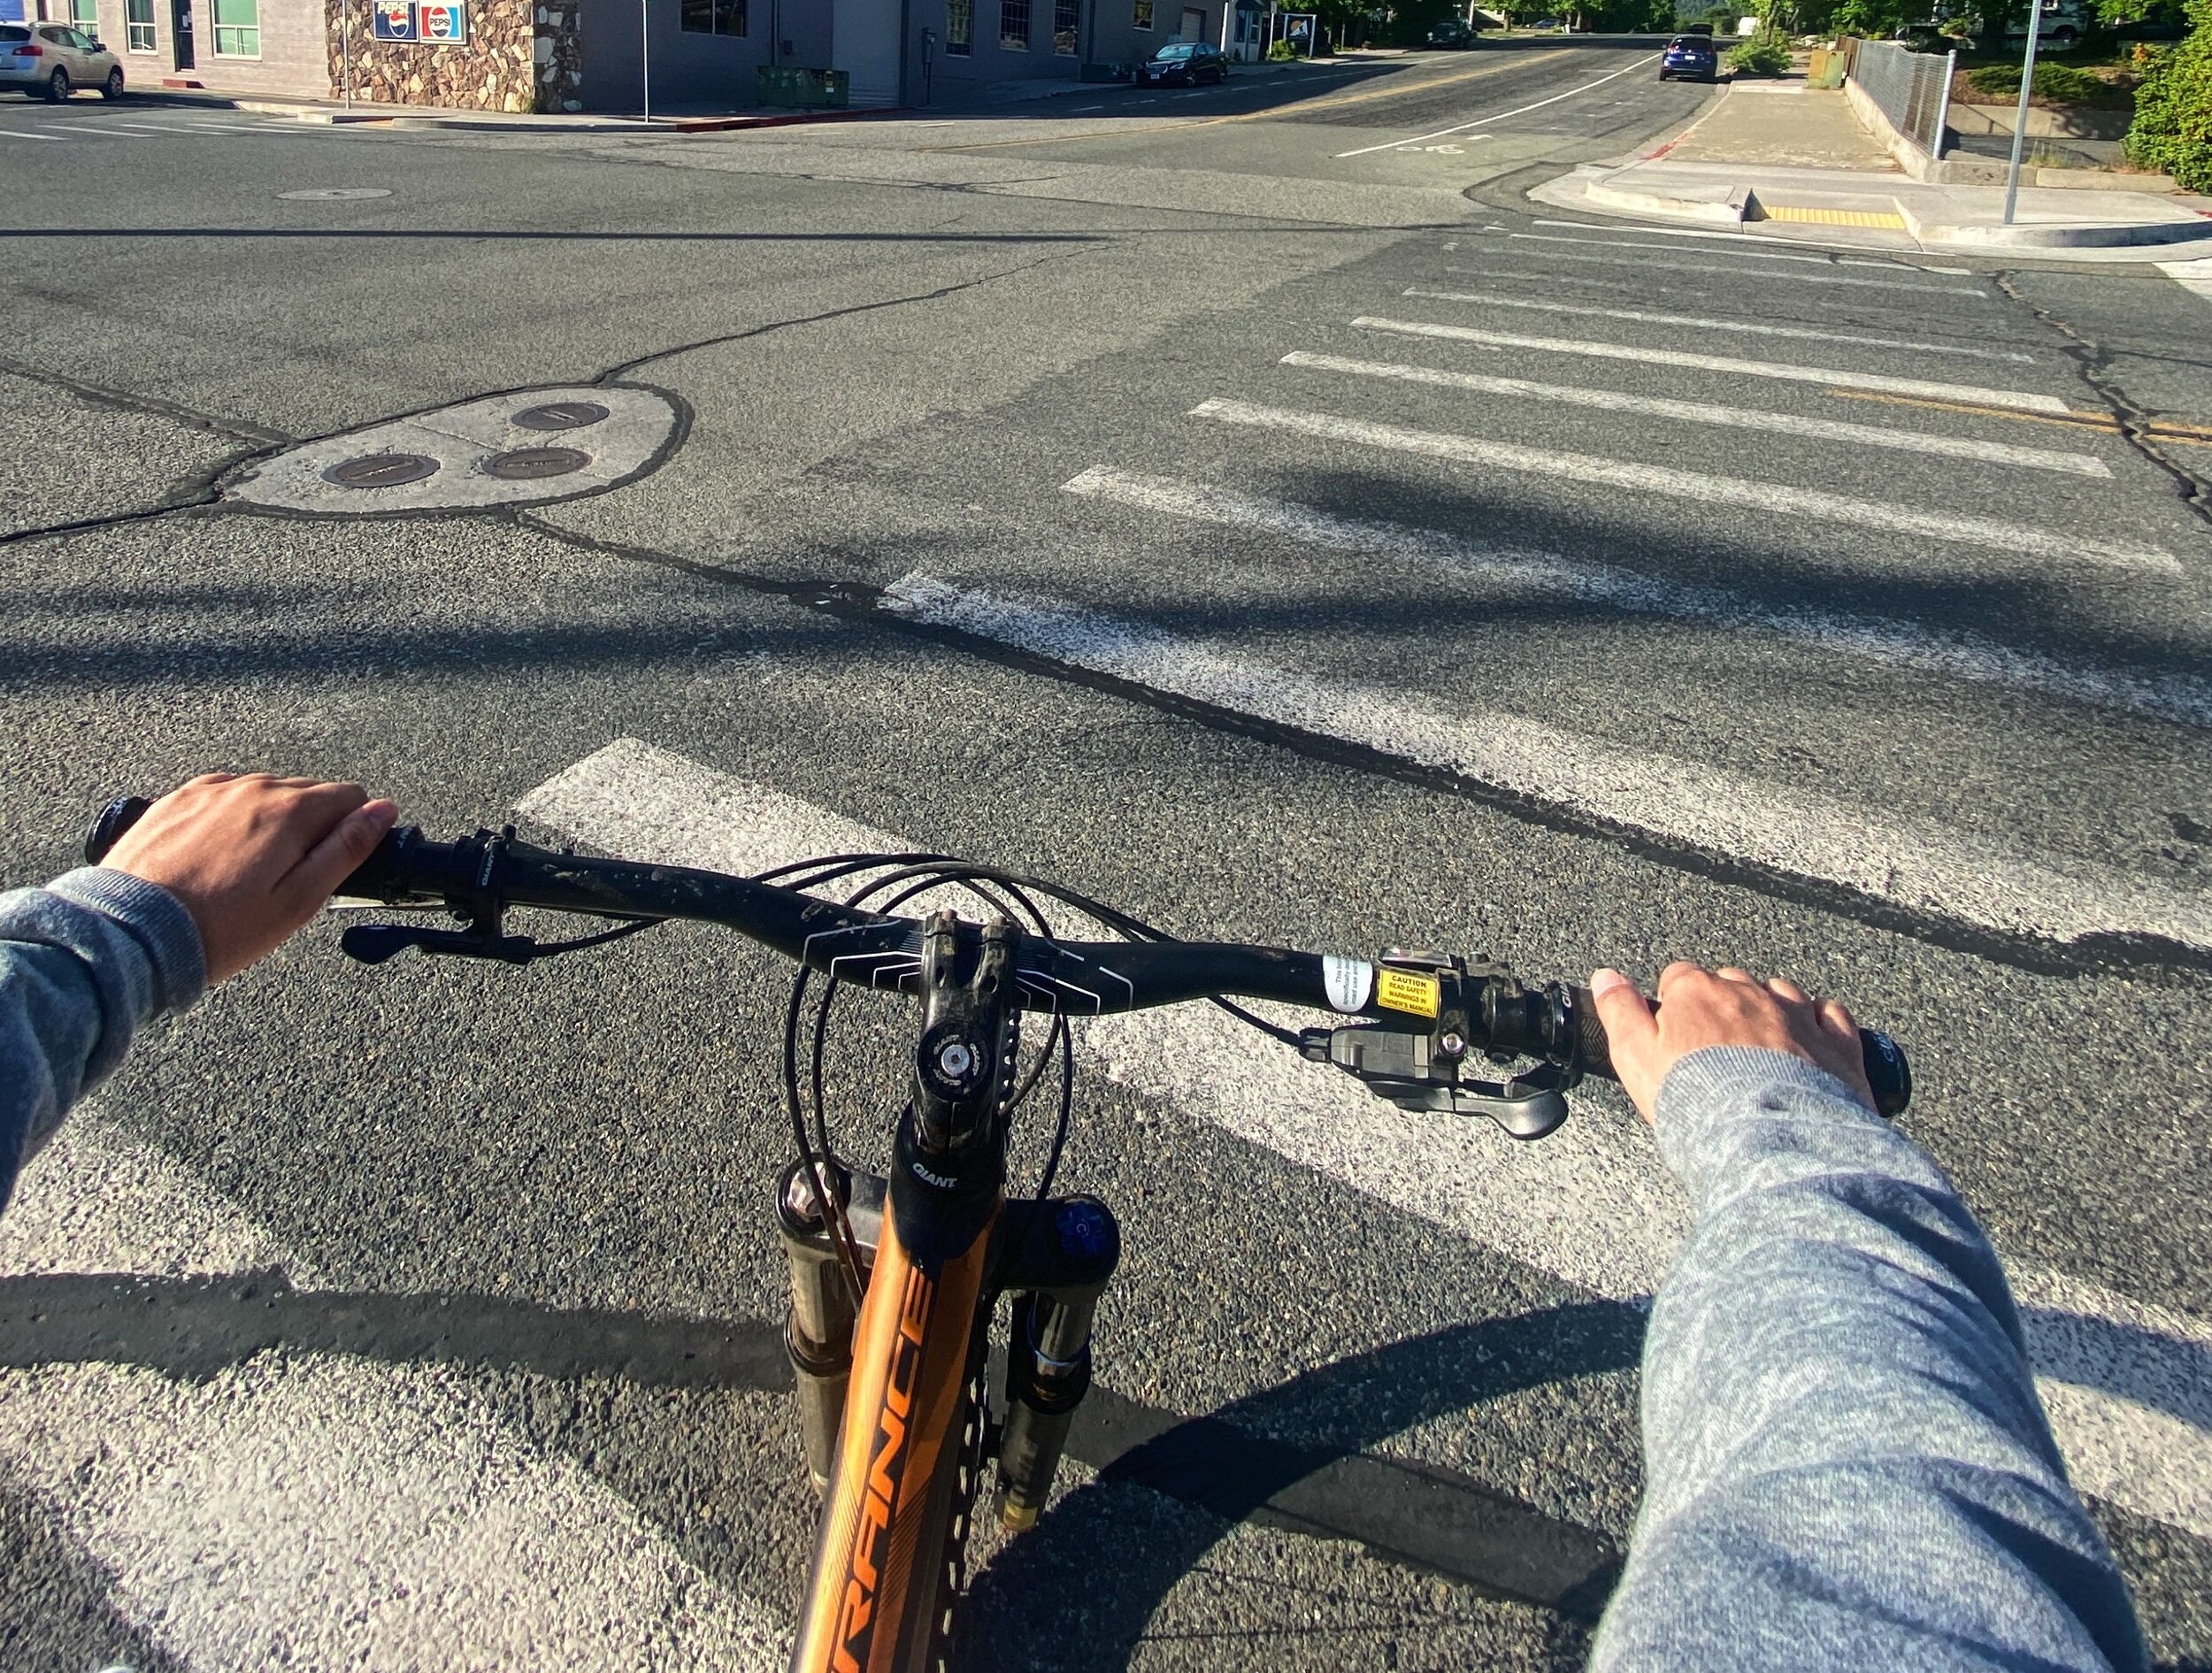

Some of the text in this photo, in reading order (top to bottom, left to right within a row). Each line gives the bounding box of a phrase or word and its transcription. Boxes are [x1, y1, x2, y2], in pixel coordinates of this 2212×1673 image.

[377, 1, 410, 14] PEPSI
[429, 18, 449, 27] PEPSI
[481, 851, 495, 886] GIANT
[1392, 975, 1427, 988] CAUTION
[1389, 982, 1427, 995] READ SAFETY
[1389, 991, 1419, 1003] WARNINGS
[1381, 997, 1433, 1015] OWNER'S MANUAL
[912, 1163, 957, 1188] GIANT
[830, 1265, 932, 1673] RANCE
